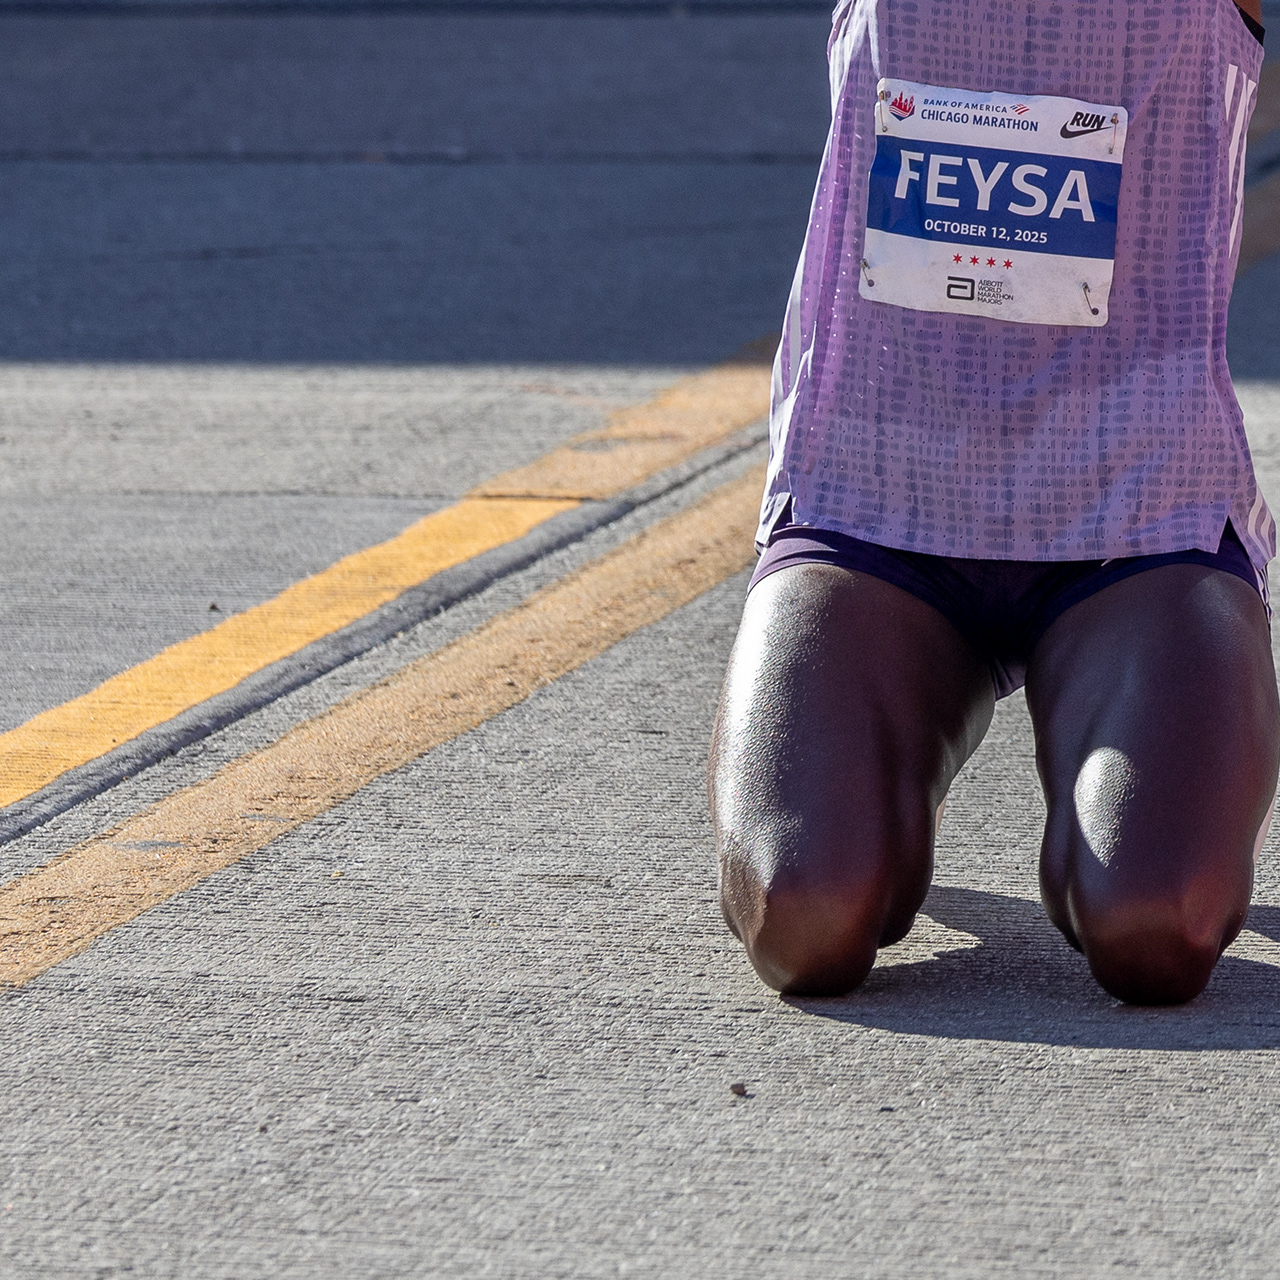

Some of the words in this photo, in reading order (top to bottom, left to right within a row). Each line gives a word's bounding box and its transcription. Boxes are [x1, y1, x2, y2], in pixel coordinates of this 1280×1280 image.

[923, 98, 949, 107] BANK
[964, 103, 1008, 113] AMERICA
[921, 108, 969, 124] CHICAGO
[972, 114, 1039, 132] MARATHON
[1069, 111, 1106, 130] RUN
[894, 149, 1096, 222] FEYSA
[924, 219, 987, 237] OCTOBER
[991, 227, 1010, 241] 12,
[1014, 229, 1048, 244] 2025
[978, 279, 1004, 288] ABBOTT
[978, 285, 1002, 293] WORLD
[977, 291, 1014, 301] MARATHON
[977, 297, 1003, 306] MAJORS
